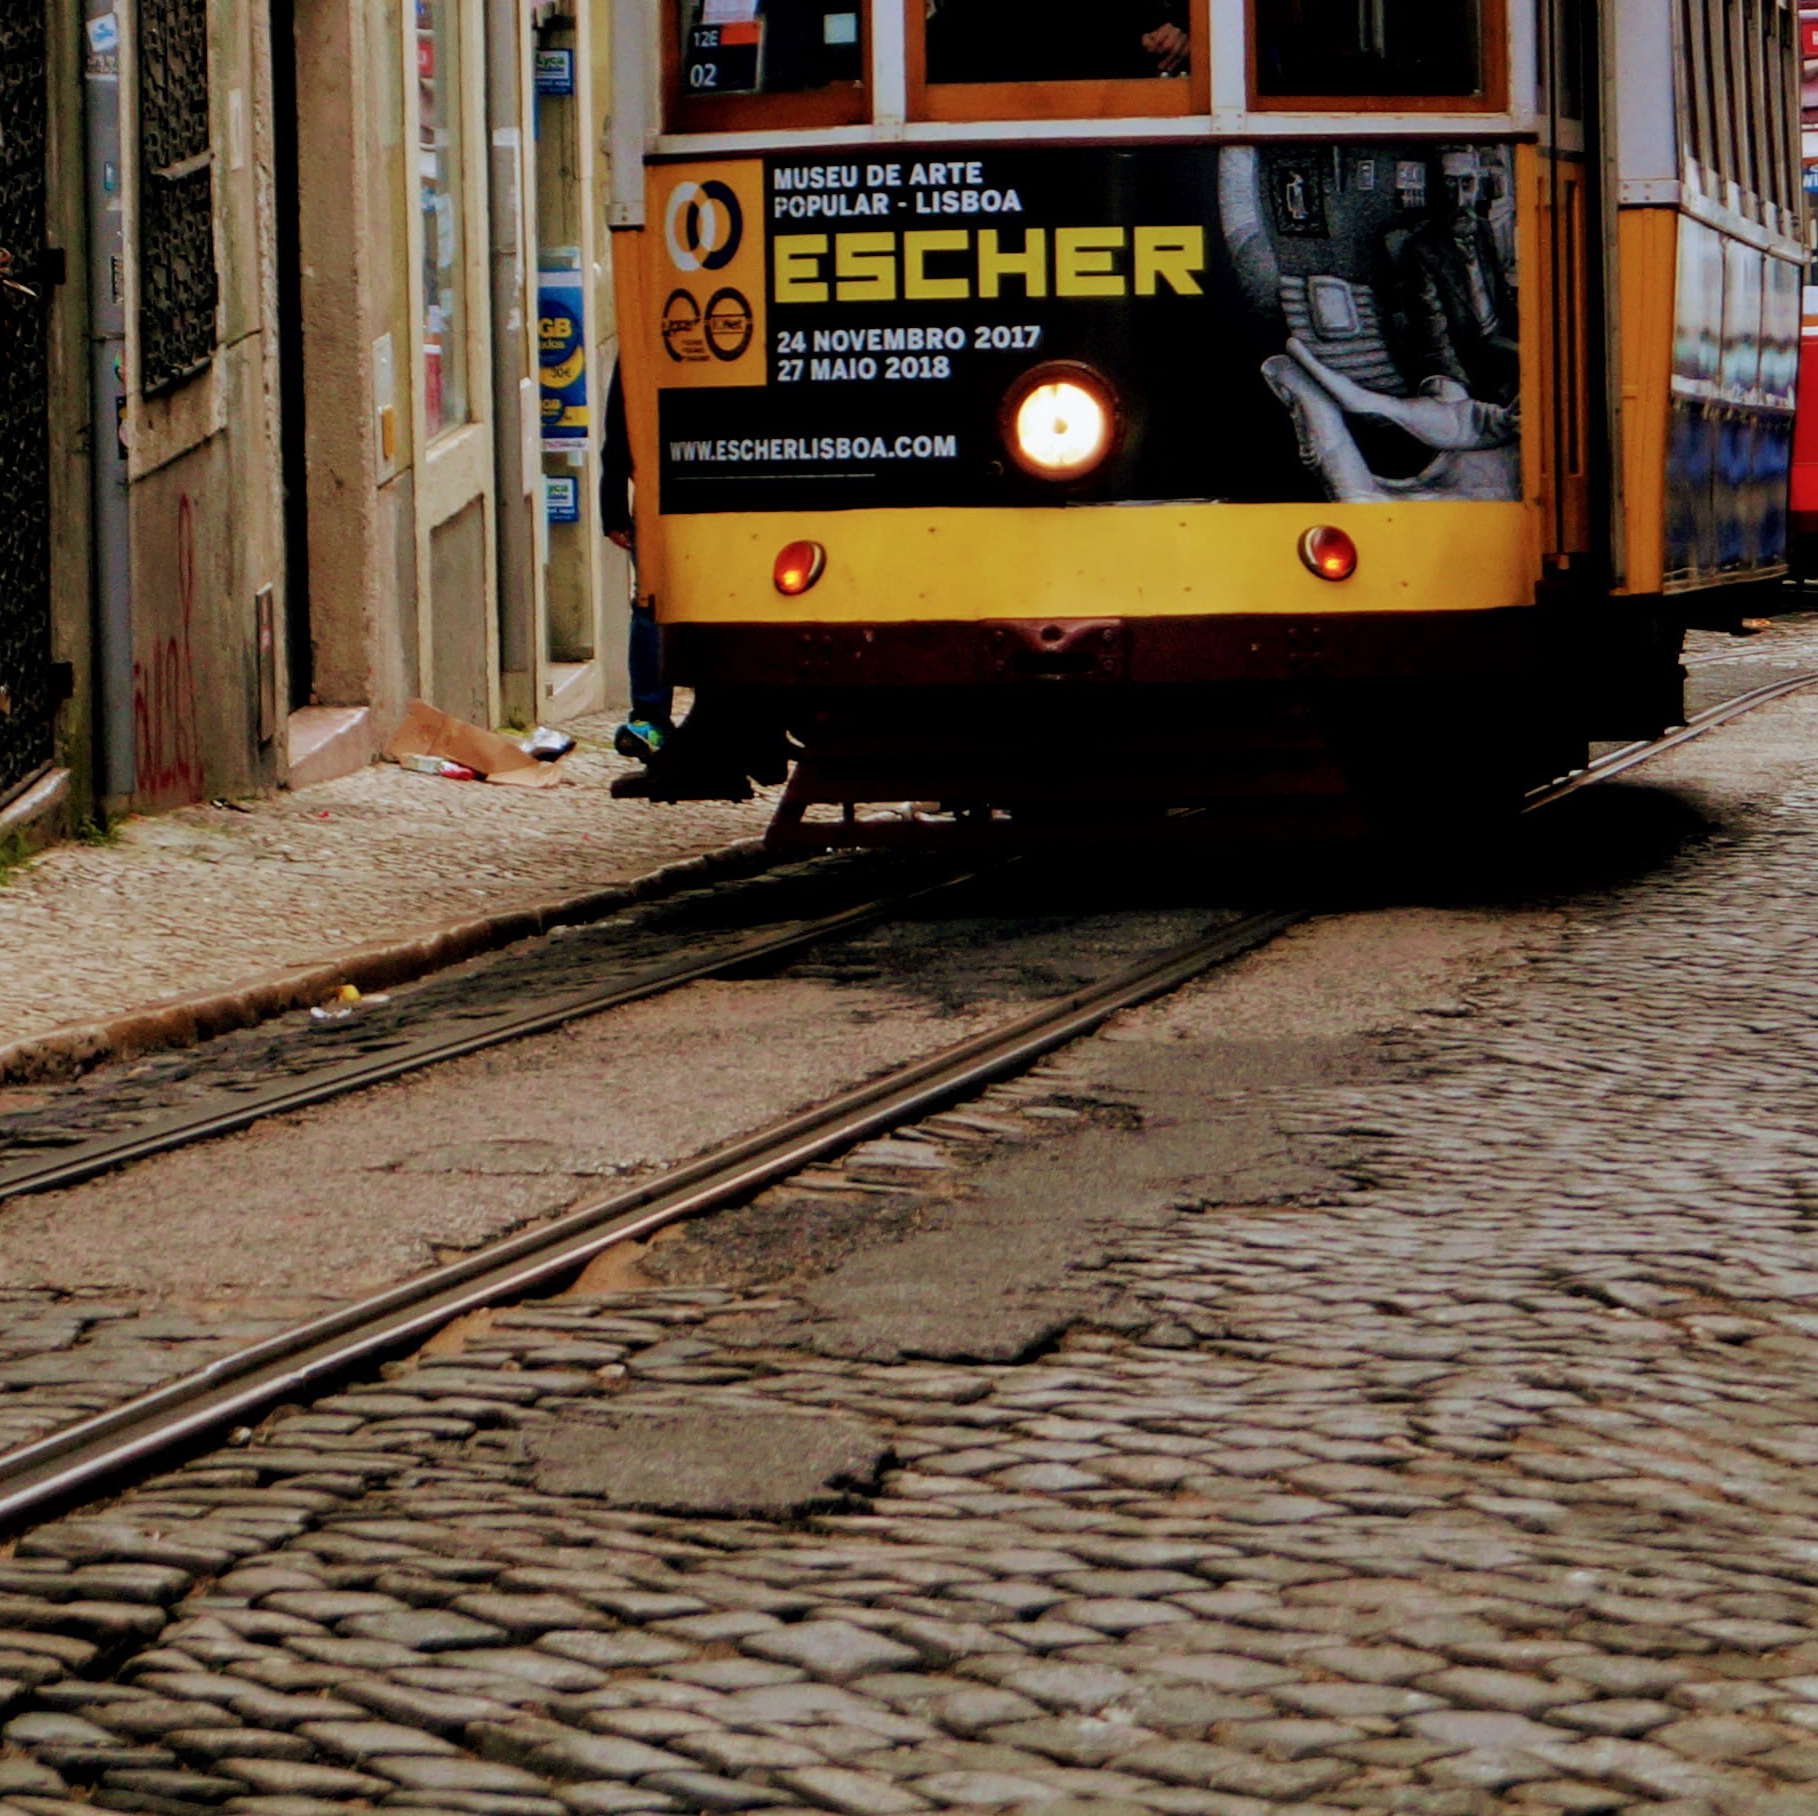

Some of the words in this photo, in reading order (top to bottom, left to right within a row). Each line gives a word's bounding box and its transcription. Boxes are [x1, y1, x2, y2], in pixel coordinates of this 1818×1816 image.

[694, 30, 719, 47] 12E
[690, 63, 717, 88] 02
[774, 165, 859, 190] MUSEU
[866, 164, 902, 187] DE
[908, 161, 984, 185] ARTE
[774, 192, 890, 218] POPULAR
[915, 189, 1023, 214] LISBOA
[773, 225, 1205, 303] ESCHER
[777, 331, 807, 353] 24
[813, 326, 966, 352] NOVEMBRO
[973, 325, 1041, 349] 2017
[777, 359, 804, 382] 27
[810, 357, 877, 381] MAIO
[884, 355, 951, 379] 2018
[669, 435, 957, 462] WWW.ESCHERLISBOA.COM
